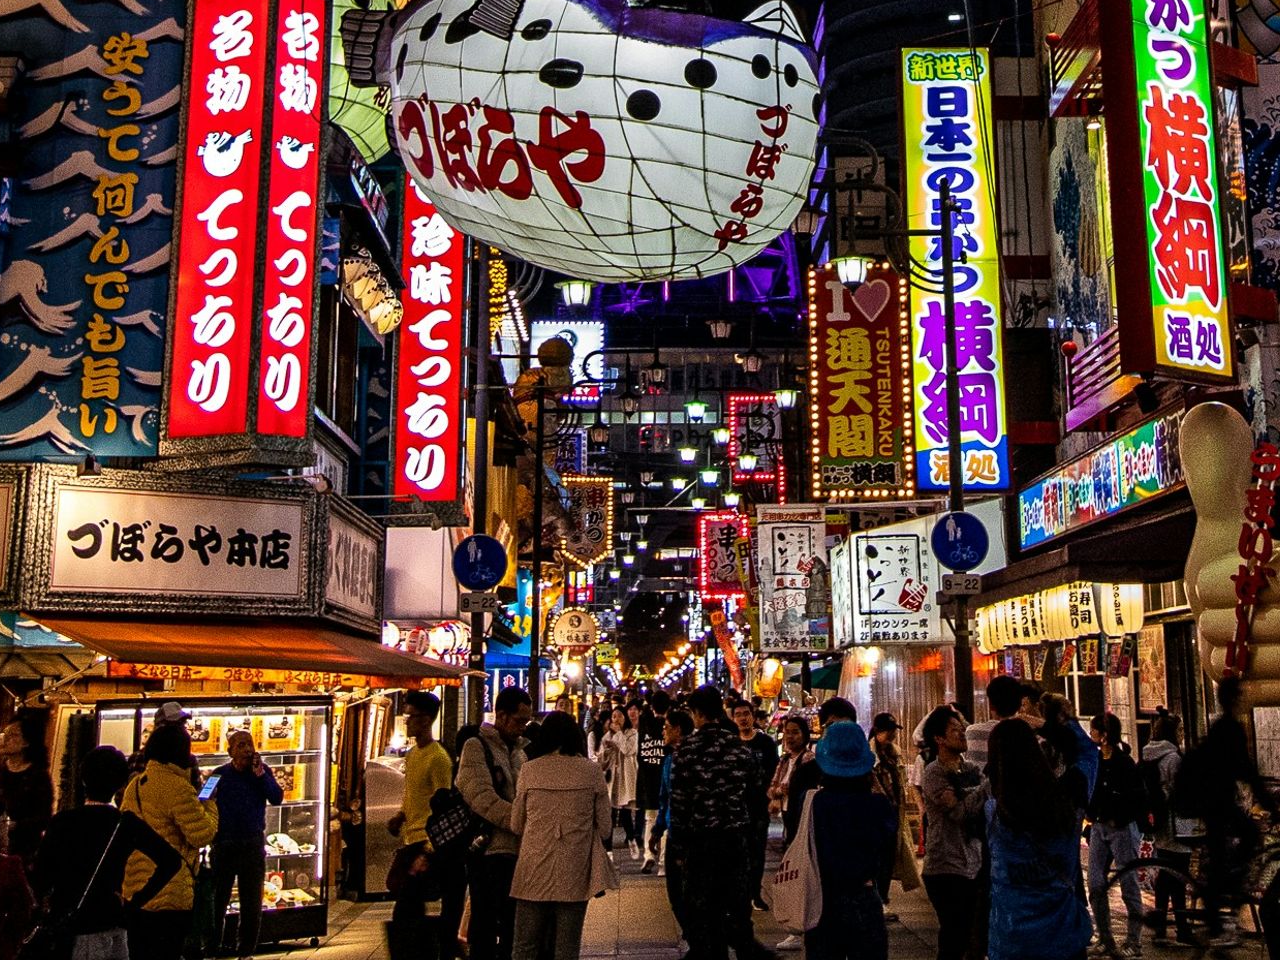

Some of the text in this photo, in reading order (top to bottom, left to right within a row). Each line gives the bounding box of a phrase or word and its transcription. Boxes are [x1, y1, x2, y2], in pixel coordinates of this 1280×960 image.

[206, 10, 254, 115] 名物
[280, 10, 320, 113] 名物
[908, 56, 982, 81] 新世界
[401, 95, 606, 209] づぼらや
[714, 105, 793, 250] づぼらや
[1145, 86, 1220, 312] 横綱
[80, 31, 149, 437] 安うて何んでも旨い
[825, 327, 874, 458] 通天閣
[875, 327, 893, 456] TSUTENKAKU
[919, 301, 997, 444] 横綱
[1167, 313, 1222, 367] 酒処
[67, 520, 293, 571] づぼらや本店
[944, 579, 980, 591] 9-22
[463, 596, 496, 610] 9-22
